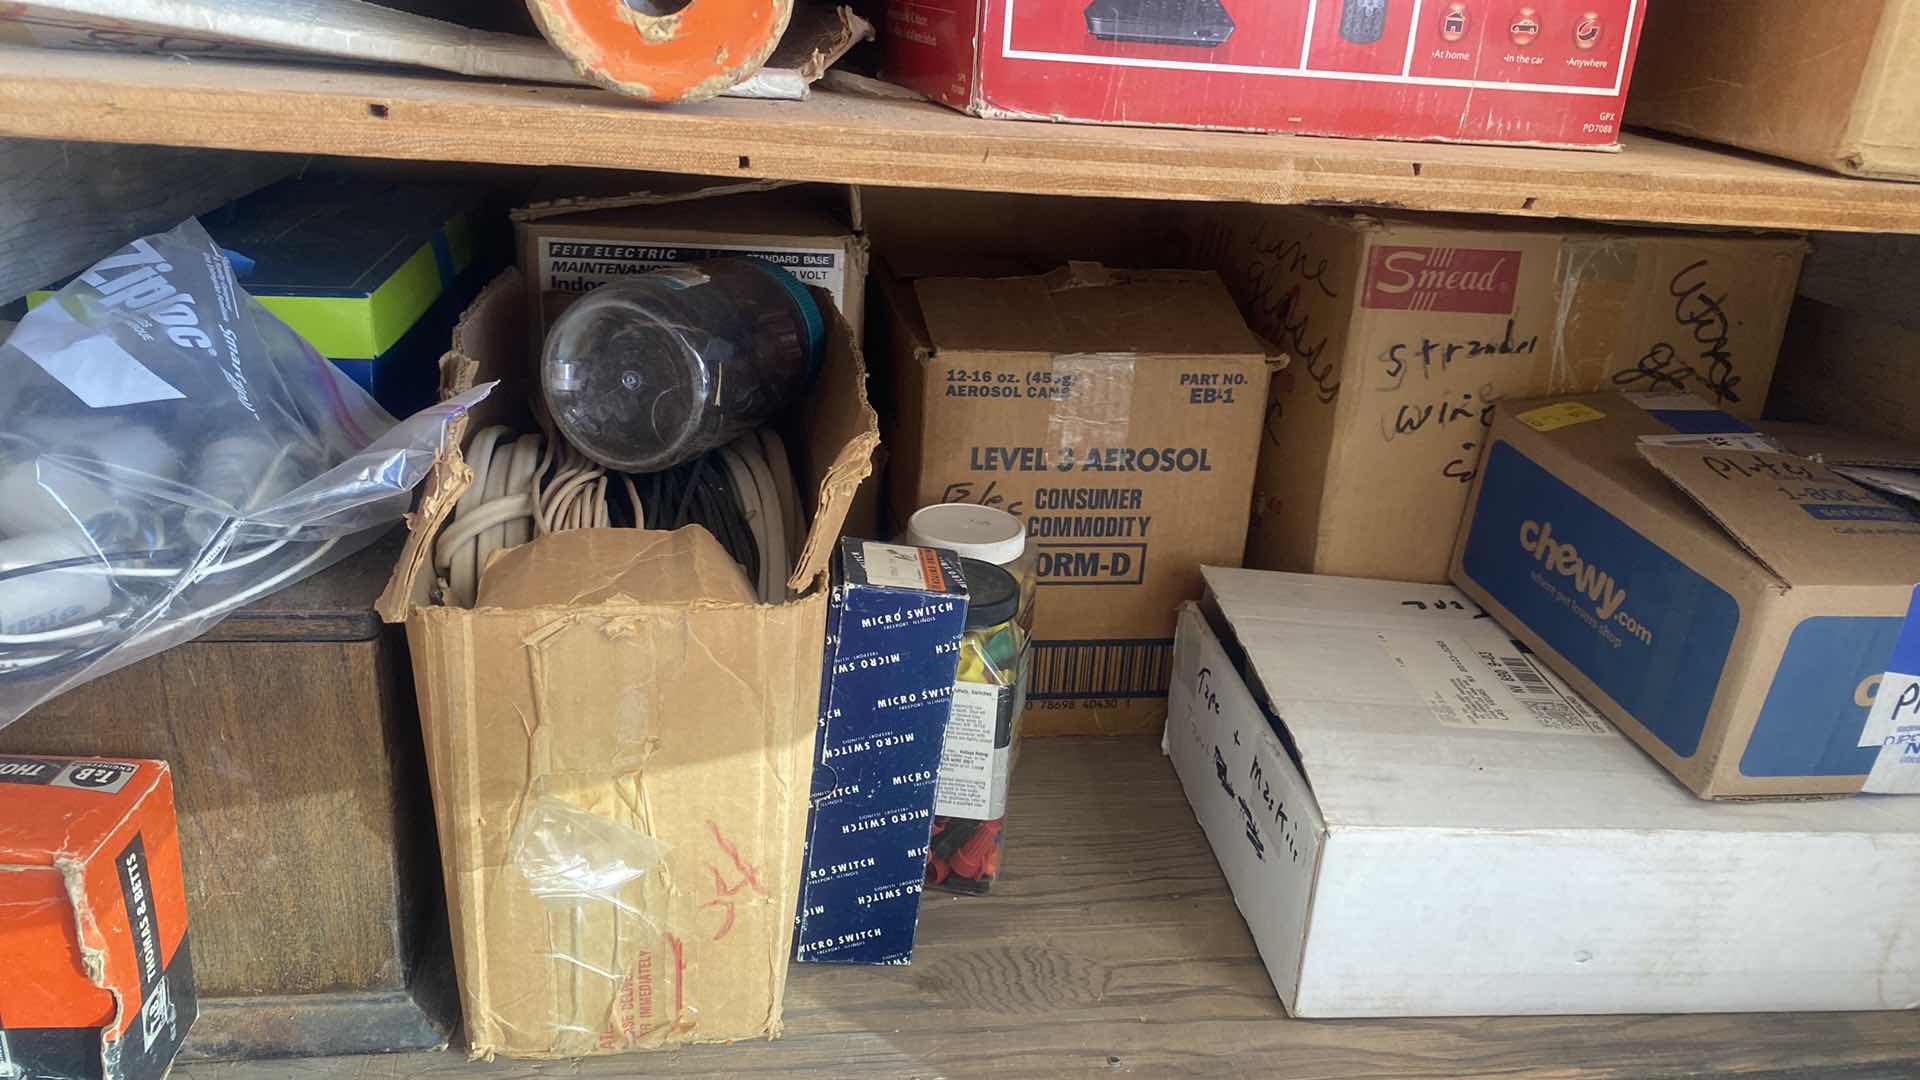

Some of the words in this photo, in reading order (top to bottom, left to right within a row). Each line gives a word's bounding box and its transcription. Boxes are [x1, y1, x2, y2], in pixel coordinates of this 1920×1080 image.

[1446, 51, 1470, 61] home
[1517, 55, 1529, 64] the
[1530, 57, 1545, 65] car
[1568, 57, 1608, 68] Anywhere
[1599, 112, 1616, 122] GPX
[551, 244, 591, 257] FEIT
[594, 246, 678, 260] ELECTRIC
[803, 255, 831, 266] BASE
[800, 270, 829, 280] VOLT
[1375, 250, 1505, 294] Smead
[80, 238, 213, 350] Ziploc
[947, 370, 993, 384] 12-16
[997, 372, 1021, 384] oz.
[1180, 373, 1221, 386] PART
[1222, 373, 1249, 387] NO.
[946, 385, 1023, 398] AEROSOL
[1189, 388, 1235, 404] EB-1
[970, 447, 1048, 471] LEVEL
[1081, 448, 1212, 472] AEROSOL
[1035, 488, 1143, 510] CONSUMER
[1027, 516, 1152, 537] COMMODITY
[1035, 552, 1132, 577] ORM-D
[861, 612, 901, 628] MICRO
[907, 601, 954, 620] SWITCH
[860, 653, 901, 669] MICRO
[877, 692, 918, 709] MICRO
[875, 733, 915, 749] MICRO
[824, 741, 871, 760] SWITCH
[892, 770, 931, 786] MICRO
[892, 808, 930, 824] MICRO
[842, 817, 887, 834] SWITCH
[830, 857, 876, 875] SWITCH
[126, 852, 144, 904] BETTS
[858, 888, 902, 905] SWITCH
[134, 903, 146, 917] &
[799, 938, 834, 954] MICRO
[838, 927, 883, 946] SWITCH
[138, 915, 157, 984] THOMAS
[638, 950, 652, 1018] IMMEDIATELY
